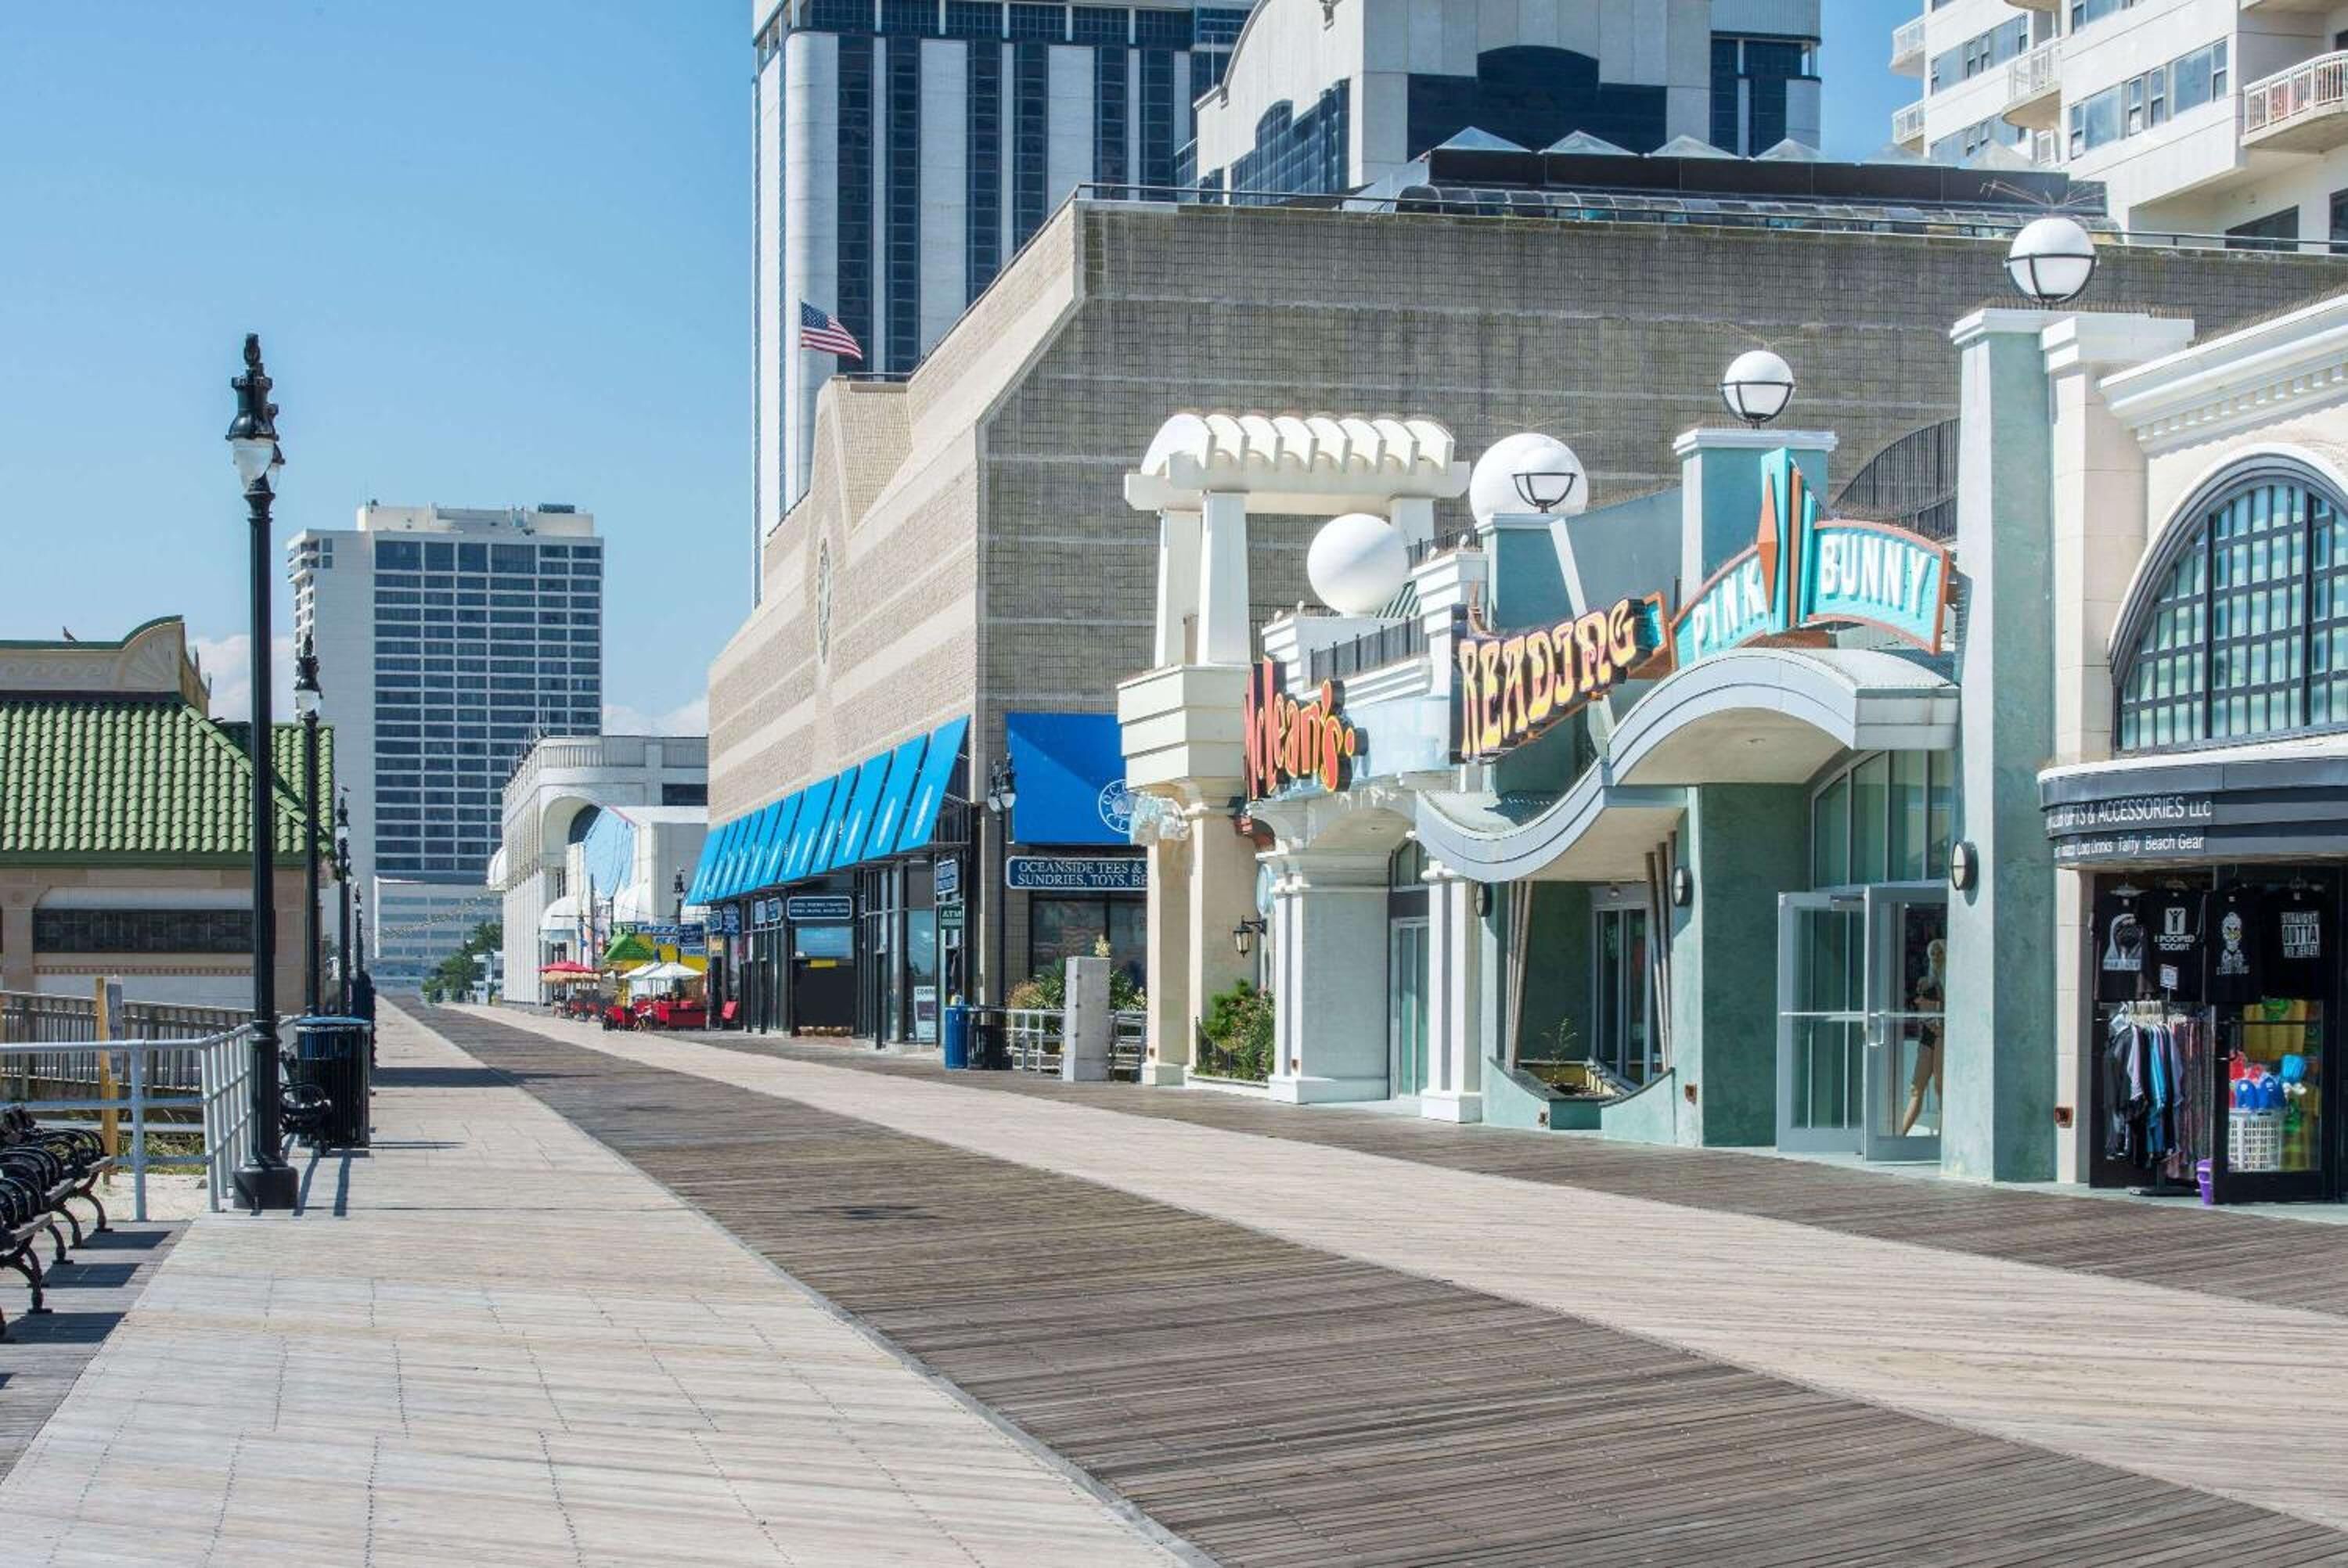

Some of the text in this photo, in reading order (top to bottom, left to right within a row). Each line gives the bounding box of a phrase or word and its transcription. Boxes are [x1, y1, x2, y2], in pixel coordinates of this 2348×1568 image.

[1691, 534, 1932, 664] PINK BUNNY
[1459, 599, 1637, 757] READING
[2087, 800, 2096, 824] &
[2098, 797, 2184, 822] ACCESSORIES
[2189, 800, 2212, 818] LLC
[2116, 836, 2141, 854] Taffy
[2145, 835, 2175, 851] Beach
[2178, 833, 2204, 850] Gear
[1019, 861, 1094, 873] OCEANSIDE
[1097, 862, 1129, 873] TEES
[1131, 863, 1143, 873] &
[1017, 874, 1087, 886] SUNDRIES,
[1089, 874, 1129, 886] TOYS,
